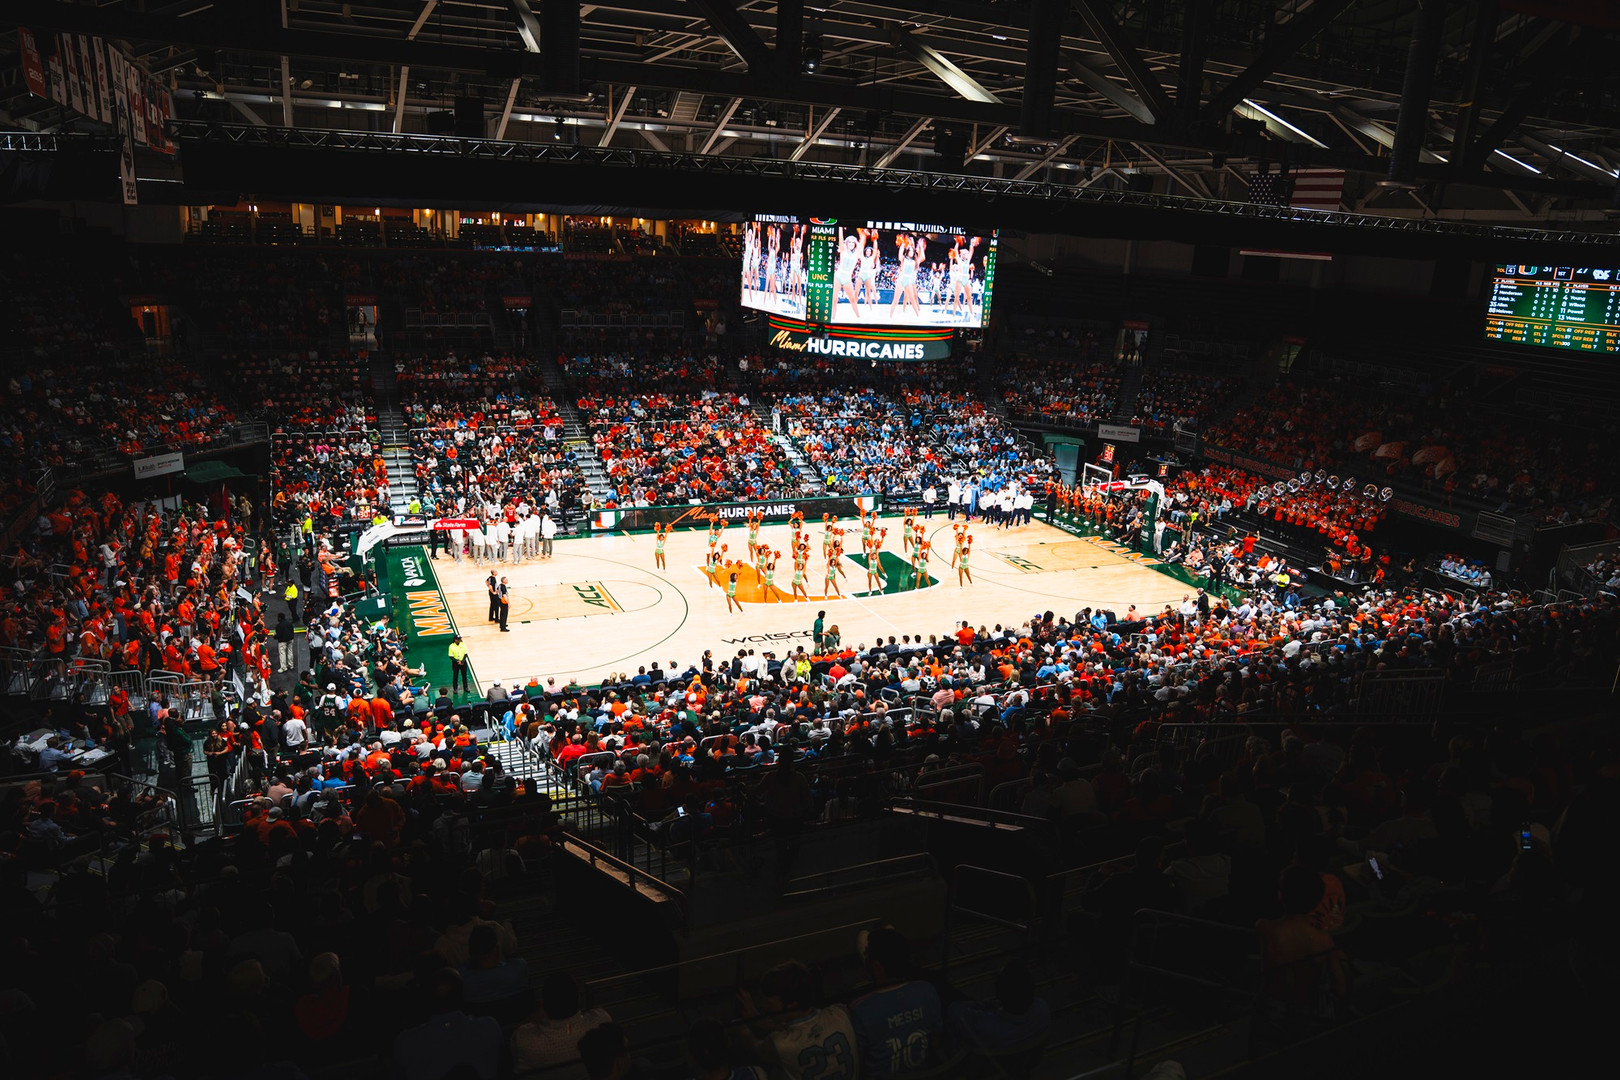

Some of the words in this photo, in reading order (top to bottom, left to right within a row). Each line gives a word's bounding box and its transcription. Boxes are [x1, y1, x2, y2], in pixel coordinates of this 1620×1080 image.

[812, 226, 835, 235] MIAMI
[770, 330, 809, 352] Miami
[807, 337, 925, 360] HURRICANES
[1234, 456, 1296, 481] HURRICANES
[719, 504, 796, 519] HURRICANES
[401, 556, 419, 580] VANDA
[995, 552, 1045, 570] ACC
[572, 585, 610, 609] ACC
[406, 590, 454, 637] MIAMI
[888, 1008, 924, 1029] MESSI
[885, 1029, 928, 1073] 10
